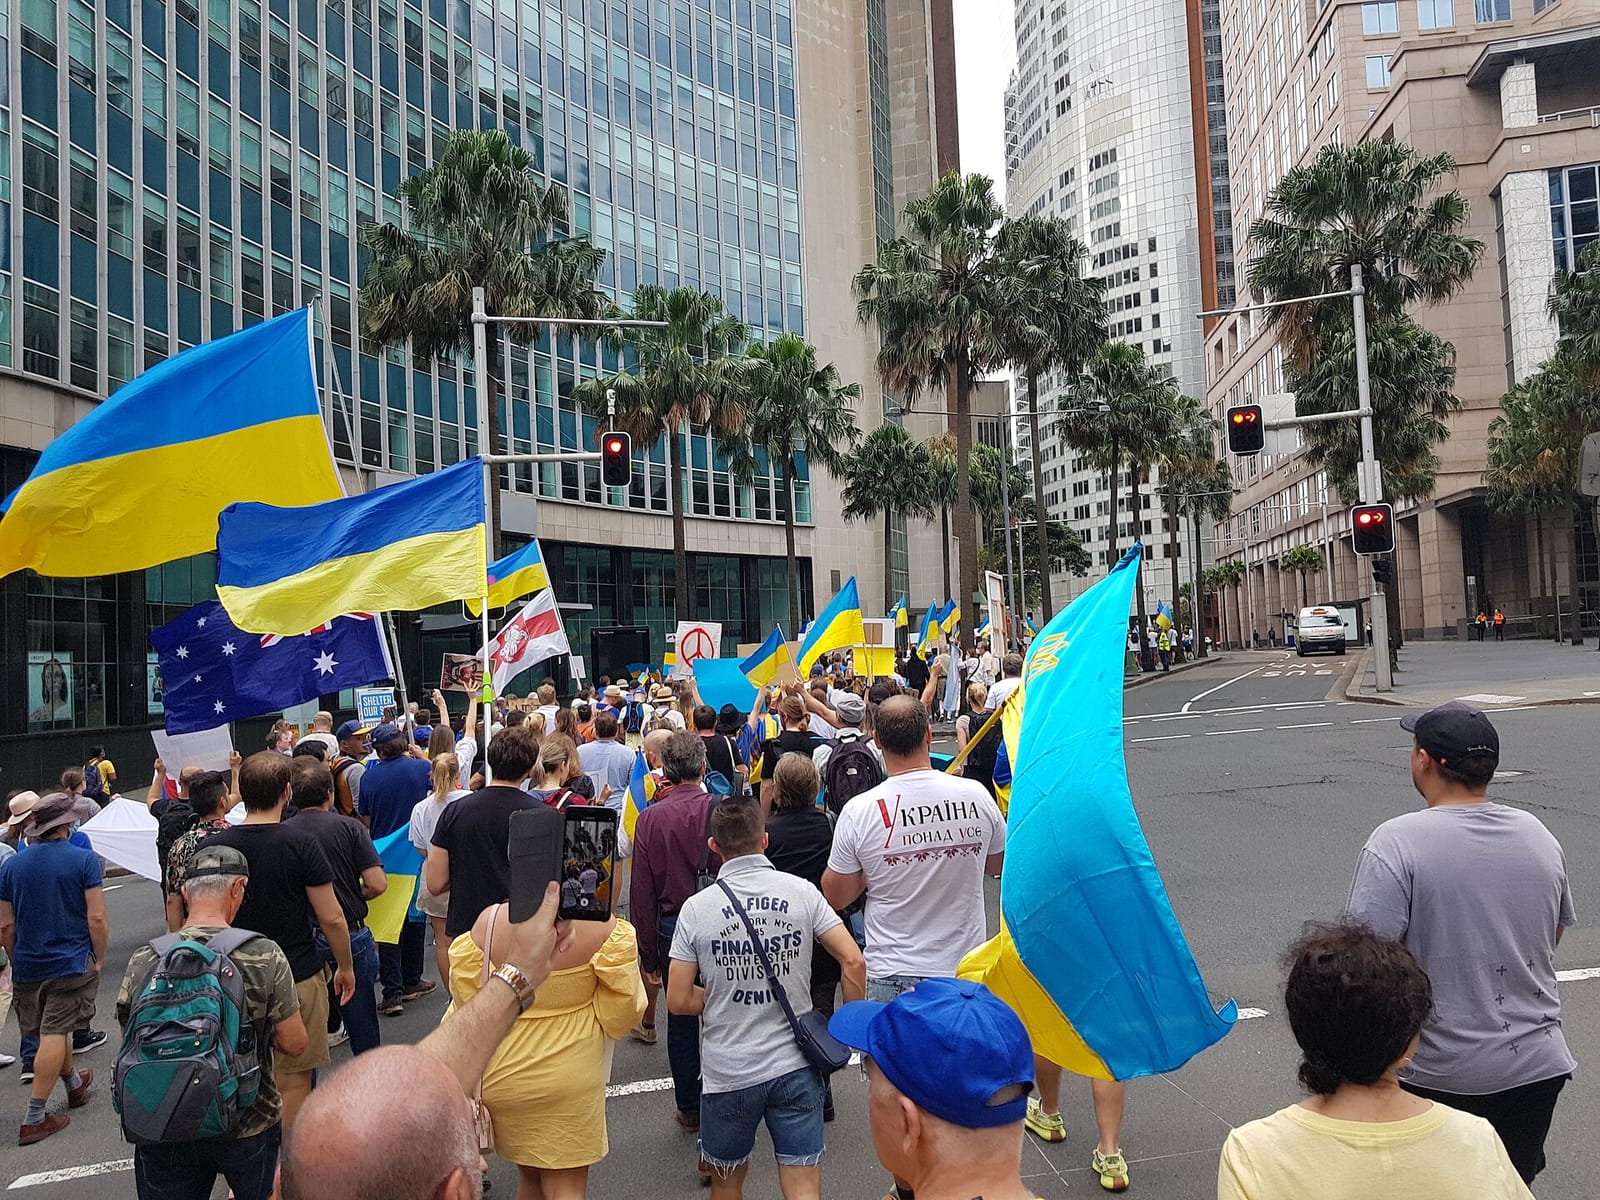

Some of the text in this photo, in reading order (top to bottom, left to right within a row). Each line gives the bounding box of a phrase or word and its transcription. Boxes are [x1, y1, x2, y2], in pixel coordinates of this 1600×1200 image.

[362, 695, 392, 706] SHELTER
[363, 706, 378, 717] OUR
[721, 896, 790, 920] HFIGER
[719, 921, 740, 939] NEW
[774, 918, 793, 932] NYC
[753, 948, 800, 965] ESTERN
[726, 961, 790, 981] DIVISON
